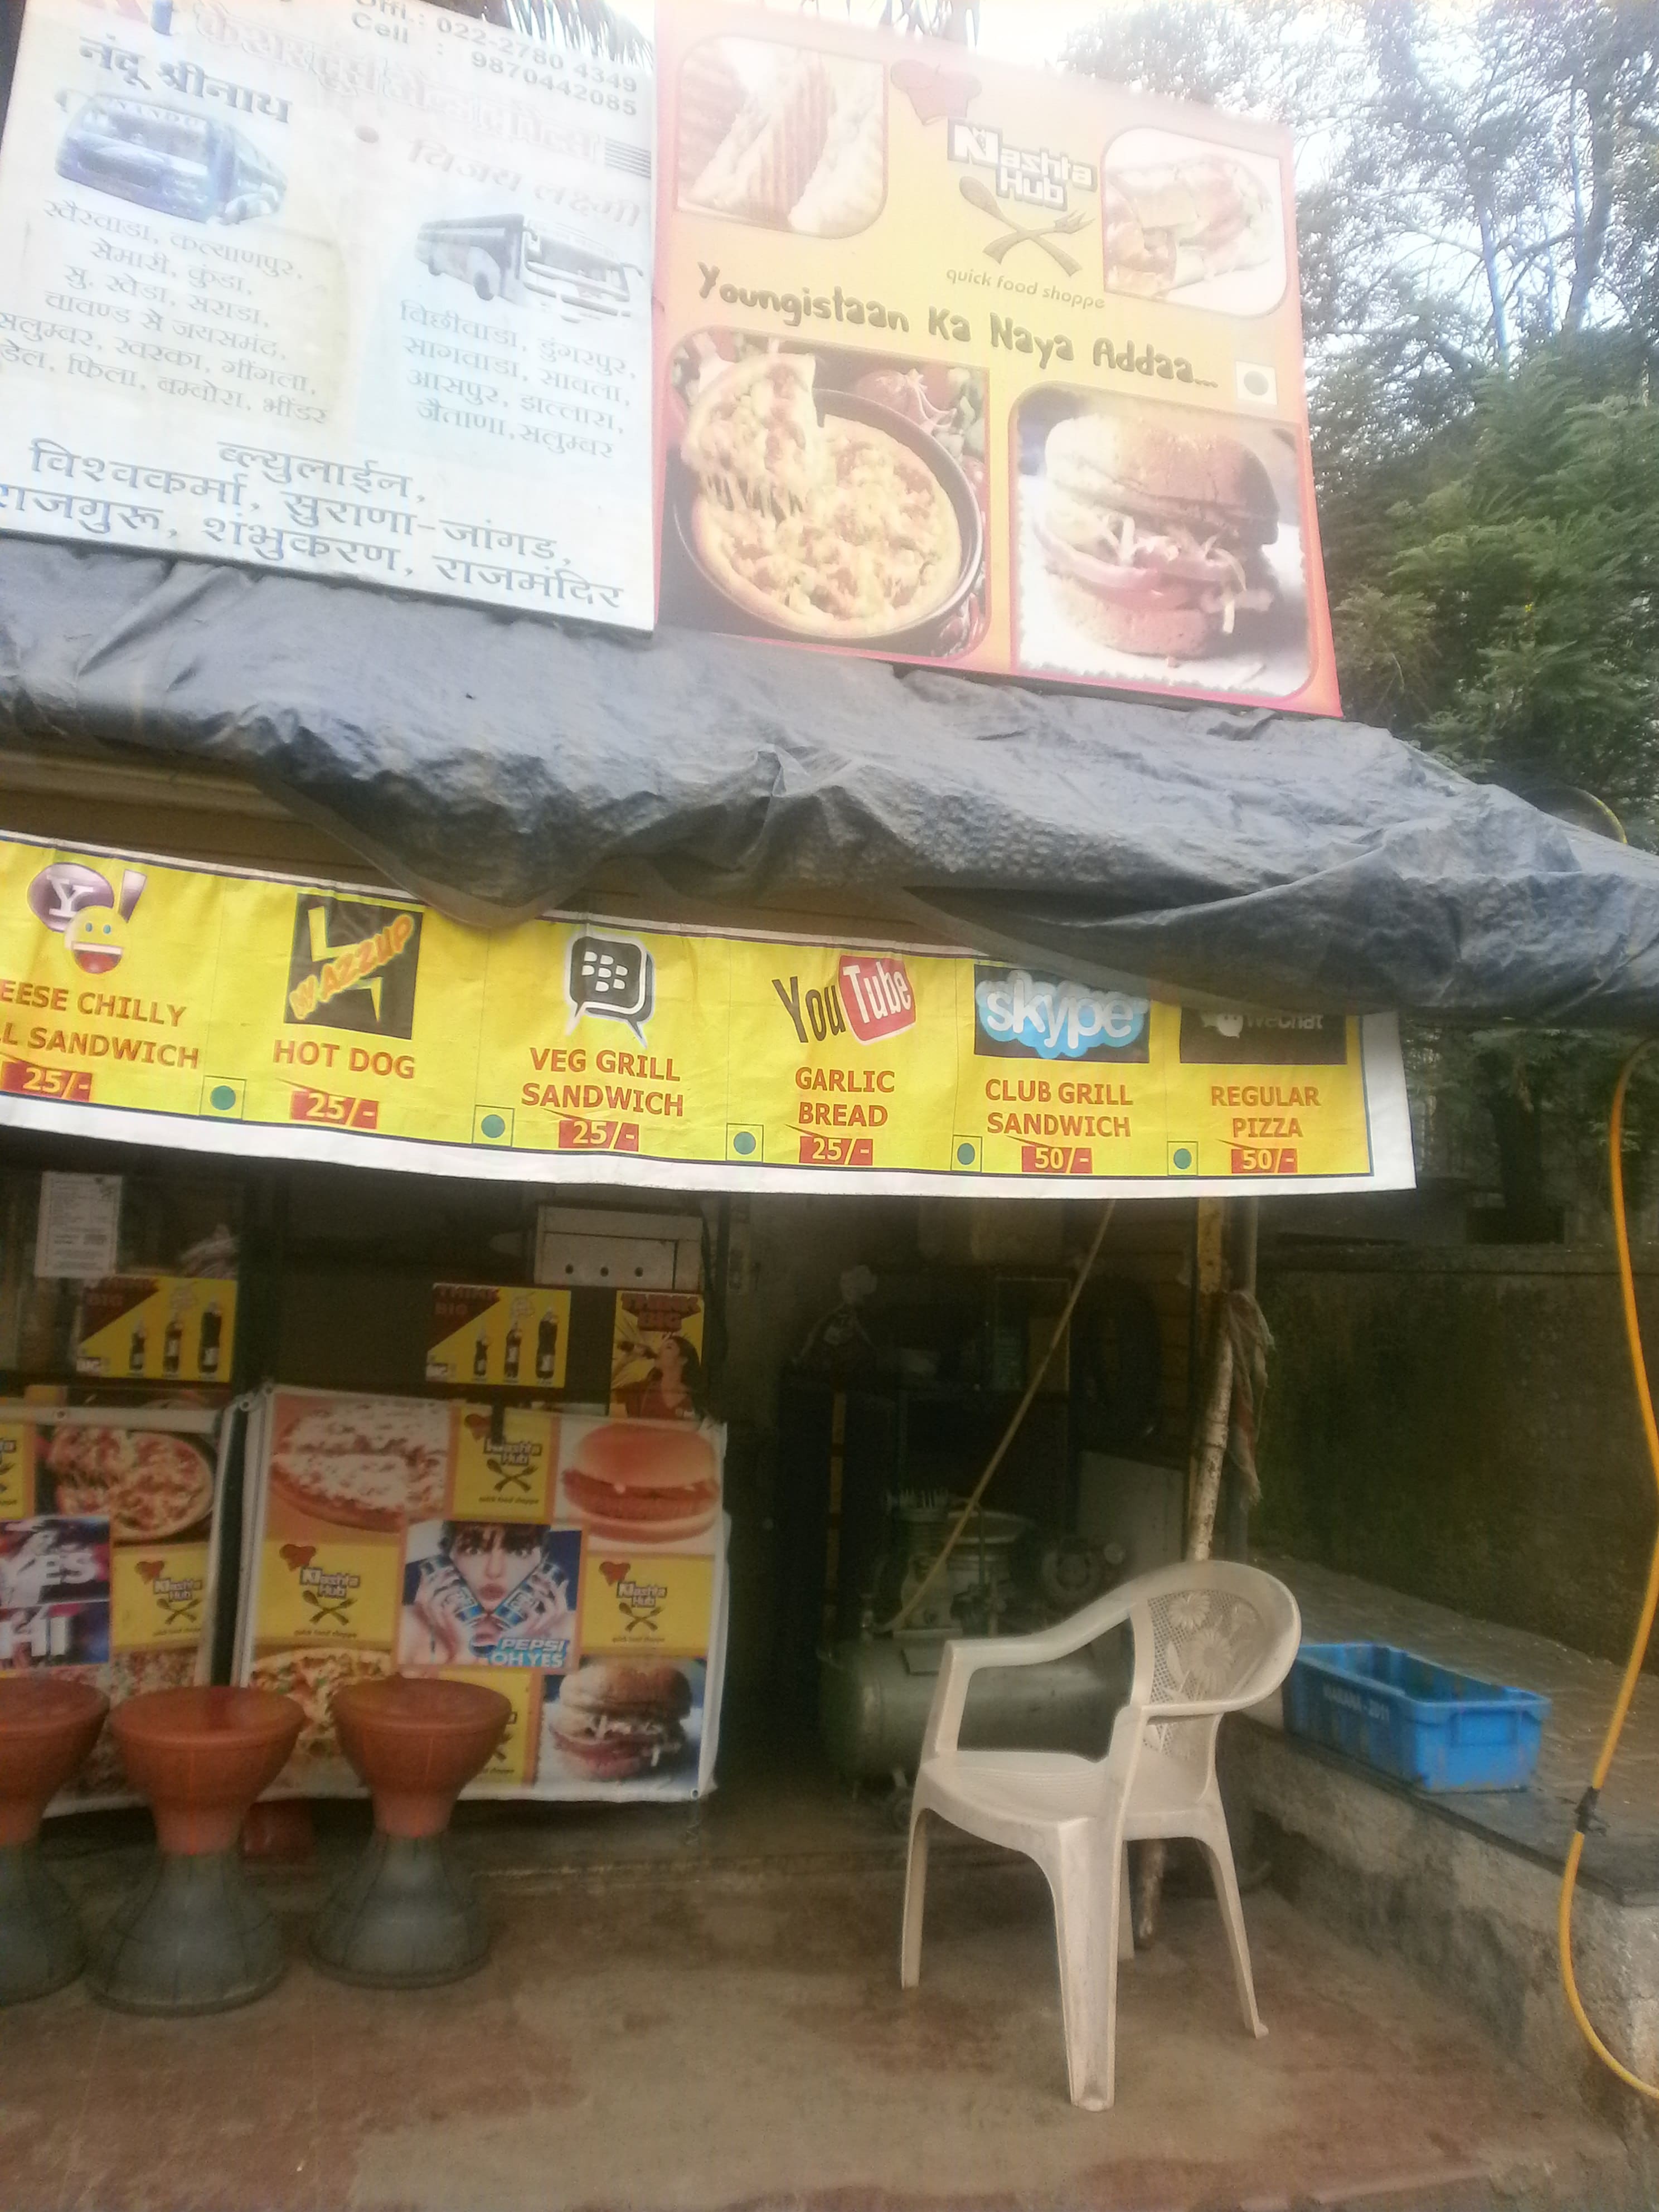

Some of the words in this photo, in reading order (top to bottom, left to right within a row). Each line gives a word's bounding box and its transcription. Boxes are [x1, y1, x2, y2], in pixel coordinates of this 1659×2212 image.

[352, 12, 408, 44] Cell
[471, 51, 637, 116] 9870442085
[436, 17, 564, 70] 022-2780
[574, 62, 637, 93] 4349
[156, 59, 293, 124] श्रीनाथ
[949, 120, 1098, 190] Nashta
[997, 167, 1067, 211] Hub
[946, 269, 991, 286] quick
[997, 275, 1038, 295] food
[1042, 285, 1106, 309] shoppe
[697, 261, 909, 332] Youngistaan
[928, 307, 971, 343] Ka
[989, 313, 1074, 370] Naya
[431, 555, 624, 608] राजमंदिर
[77, 992, 187, 1027] CHILLY
[986, 973, 1136, 1049] skype
[27, 1027, 199, 1070] SANDWICH
[273, 1039, 340, 1069] HOT
[348, 1048, 415, 1080] DOG
[530, 1047, 586, 1073] VEG
[596, 1050, 681, 1082] GRILL
[22, 1068, 90, 1100] 25/-
[794, 1067, 895, 1093] GARLIC
[985, 1079, 1052, 1103] CLUB
[1058, 1082, 1134, 1107] GRILL
[1211, 1085, 1321, 1107] REGULAR
[306, 1093, 376, 1127] 25/-
[521, 1083, 684, 1117] SANDWICH
[799, 1102, 889, 1127] BREAD
[572, 1119, 636, 1151] 25/-
[987, 1113, 1131, 1138] SANDWICH
[1232, 1117, 1303, 1138] PIZZA
[811, 1138, 871, 1165] 25/-
[1034, 1147, 1090, 1173] 50/-
[1241, 1147, 1296, 1172] 50/-
[489, 1651, 523, 1667] OH
[525, 1652, 564, 1667] YES
[500, 1639, 568, 1652] PEPSI
